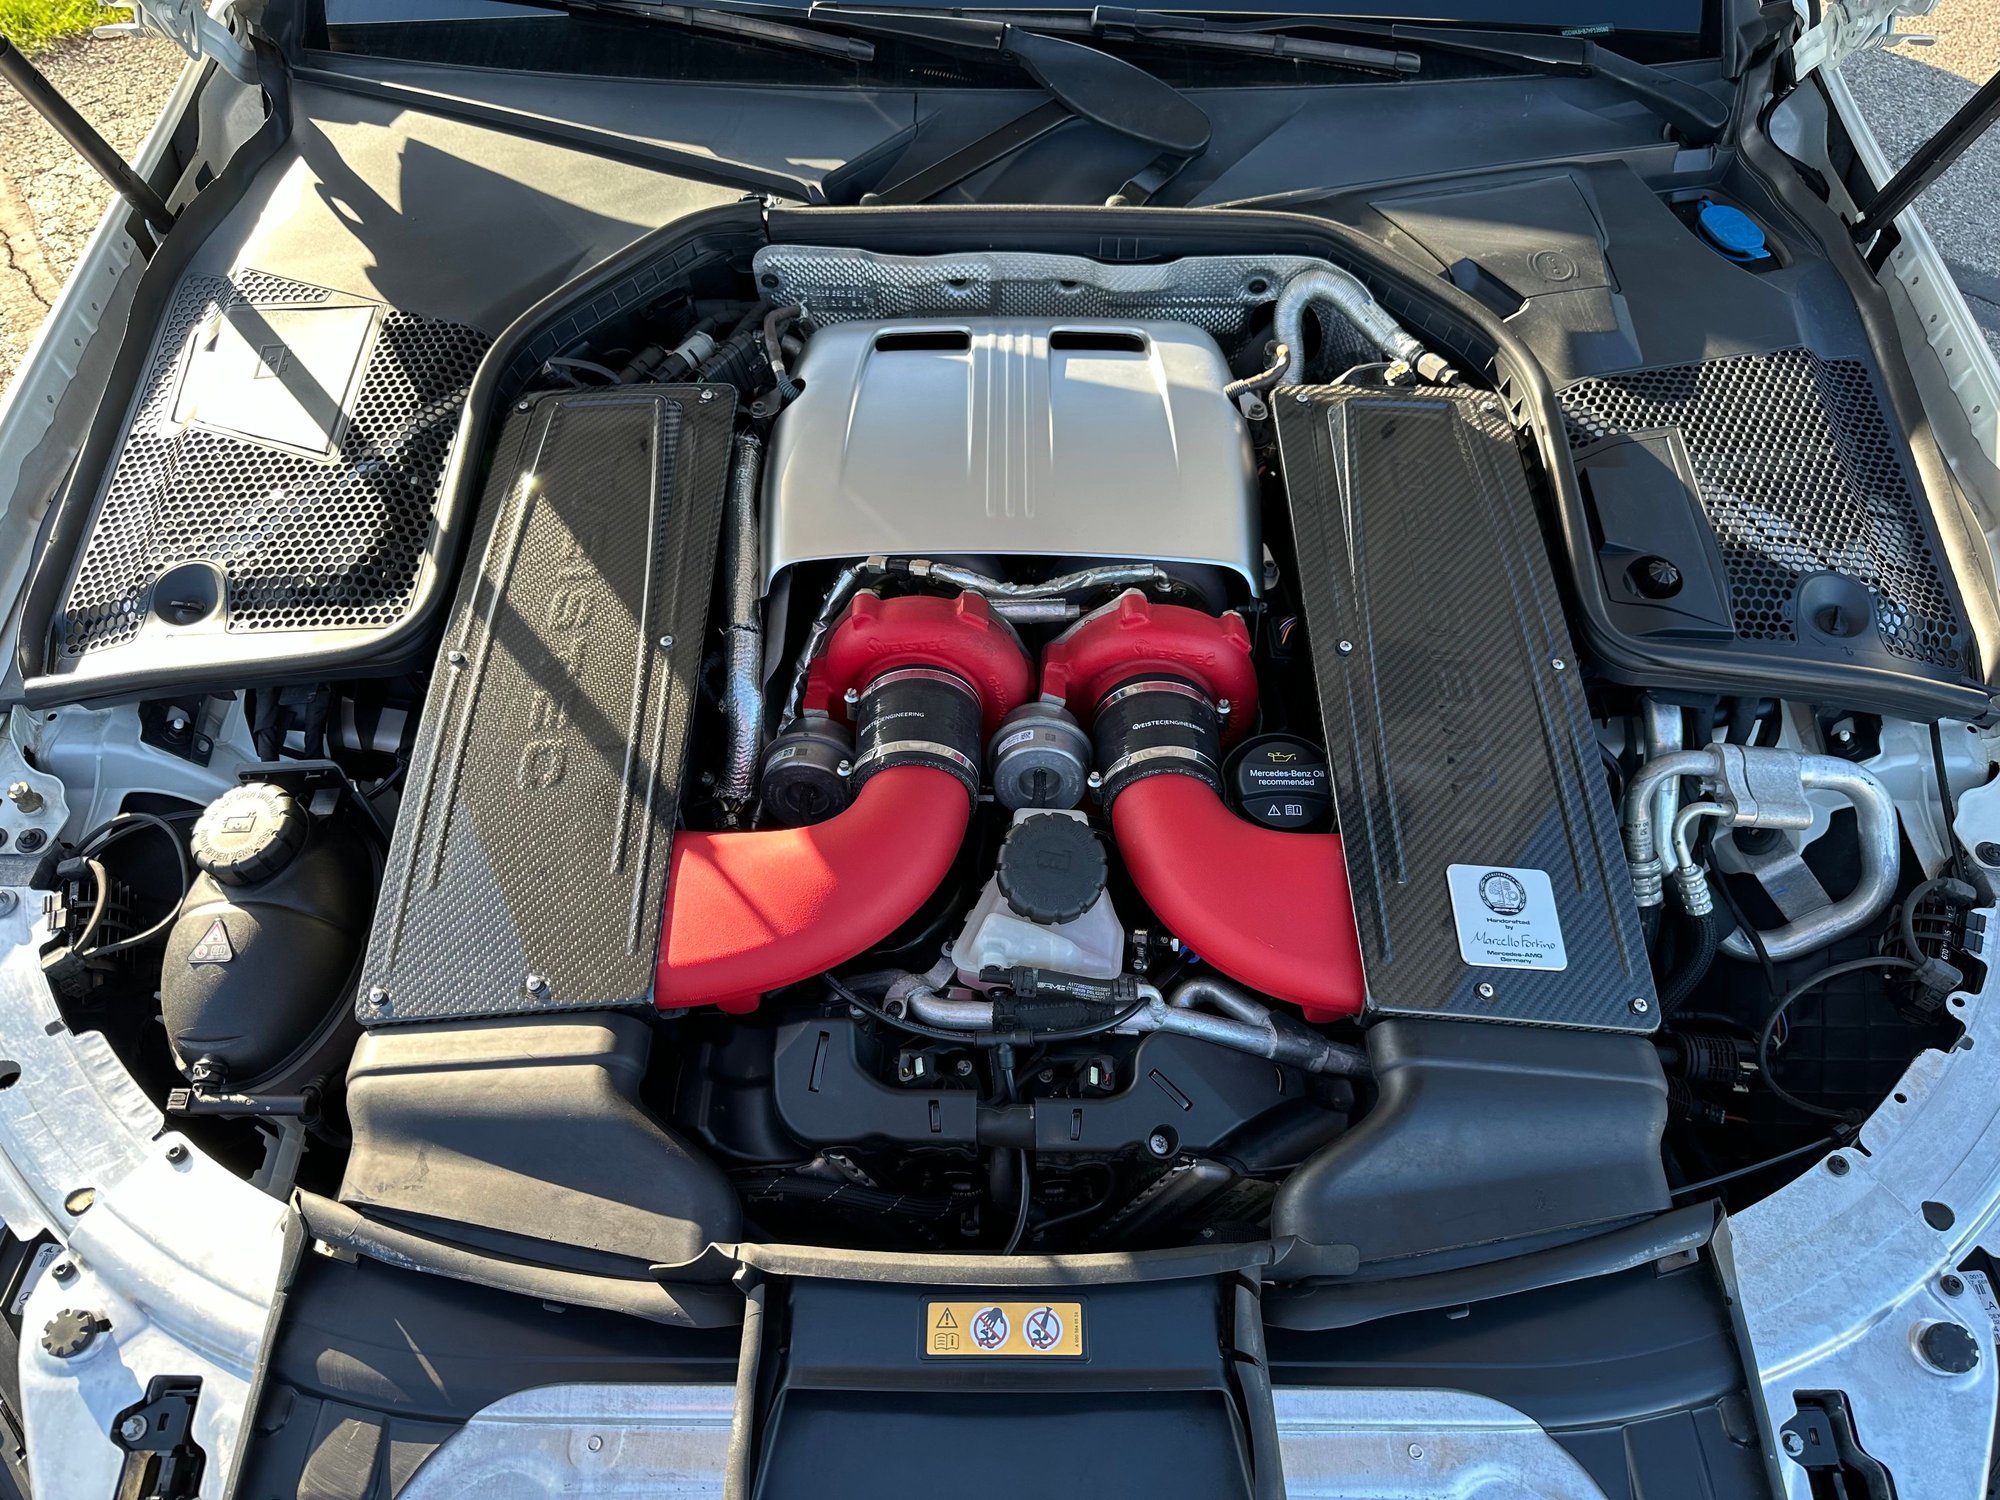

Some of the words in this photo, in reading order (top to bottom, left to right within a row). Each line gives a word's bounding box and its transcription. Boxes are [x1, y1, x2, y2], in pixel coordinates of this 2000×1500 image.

[1249, 769, 1311, 777] Mercedes-Benz
[1313, 769, 1325, 778] Oil
[1258, 778, 1315, 786] recommended
[1486, 917, 1531, 925] Handcrafted
[1471, 931, 1520, 948] Marcello
[1521, 934, 1556, 950] Fortino
[1486, 950, 1543, 959] Mercedes-AMG
[1500, 957, 1532, 965] Germany
